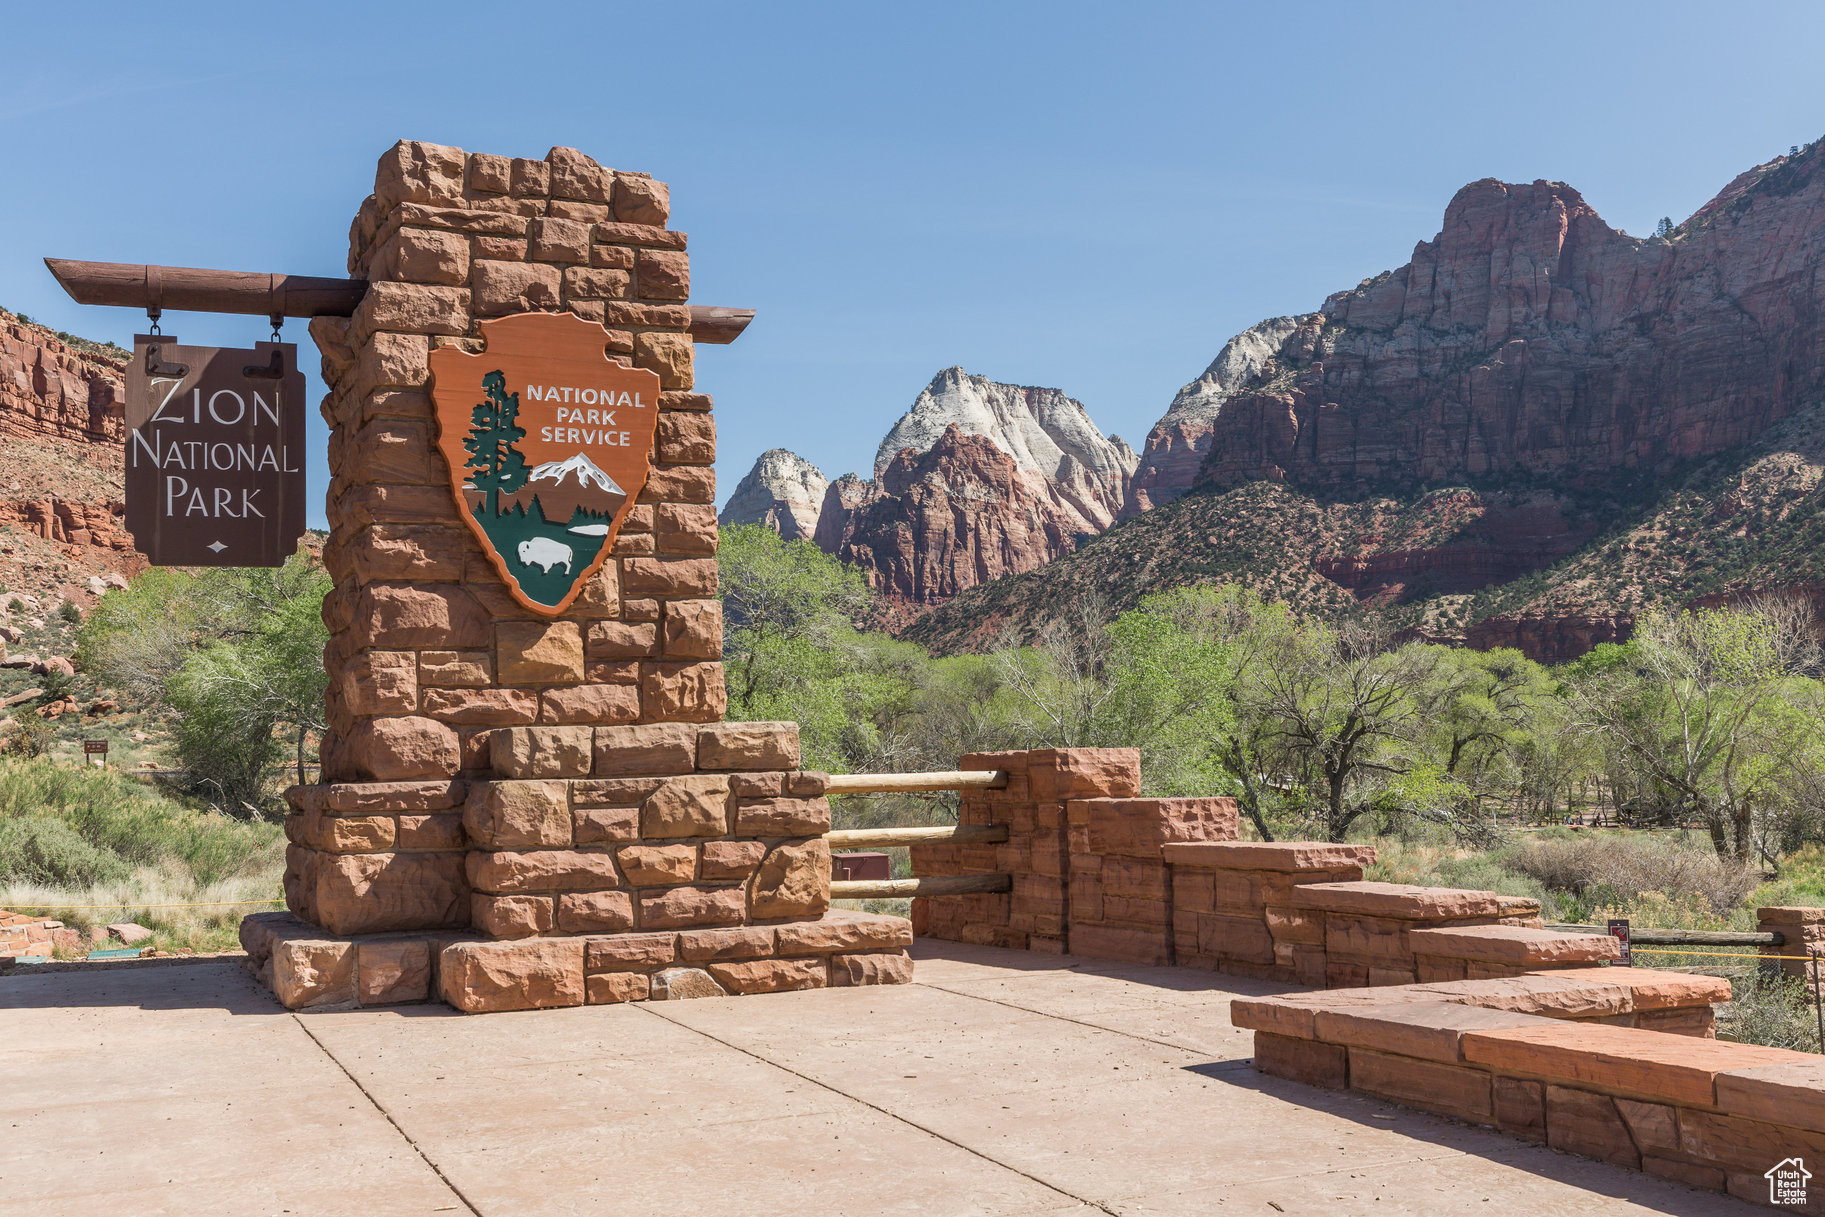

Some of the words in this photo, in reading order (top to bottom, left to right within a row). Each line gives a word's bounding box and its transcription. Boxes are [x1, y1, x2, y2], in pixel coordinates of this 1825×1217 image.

[150, 377, 280, 427] ZION
[527, 385, 646, 409] NATIONAL
[557, 407, 617, 426] PARK
[132, 428, 299, 473] NATIONAL
[541, 427, 631, 447] SERVICE
[166, 475, 267, 518] PARK
